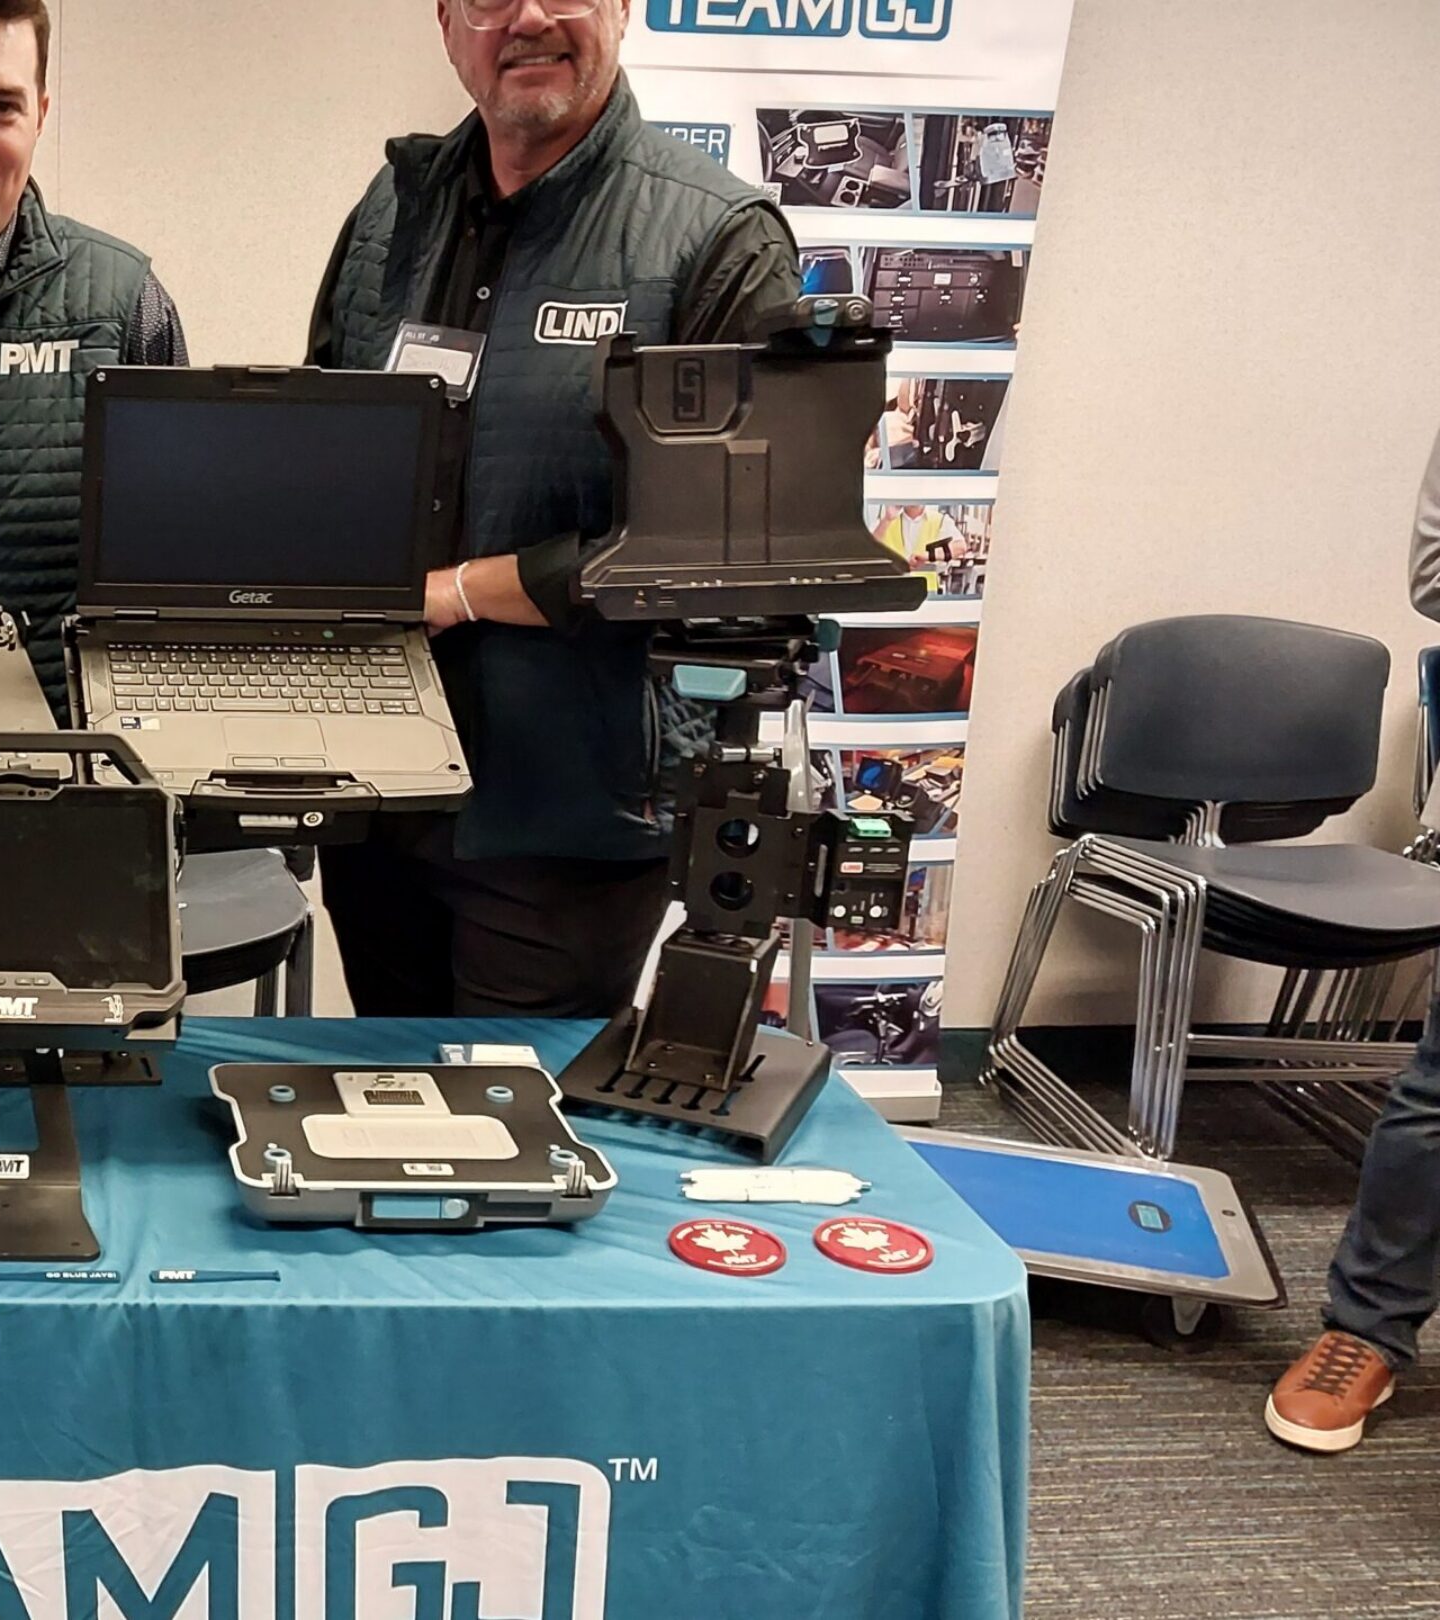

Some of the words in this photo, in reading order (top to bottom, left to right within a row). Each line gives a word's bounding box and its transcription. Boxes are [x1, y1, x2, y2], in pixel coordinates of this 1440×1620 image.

[543, 308, 620, 339] LIND
[0, 340, 79, 375] PMT
[229, 590, 273, 604] Getac
[159, 1270, 196, 1280] PMT
[324, 1479, 582, 1620] GJ
